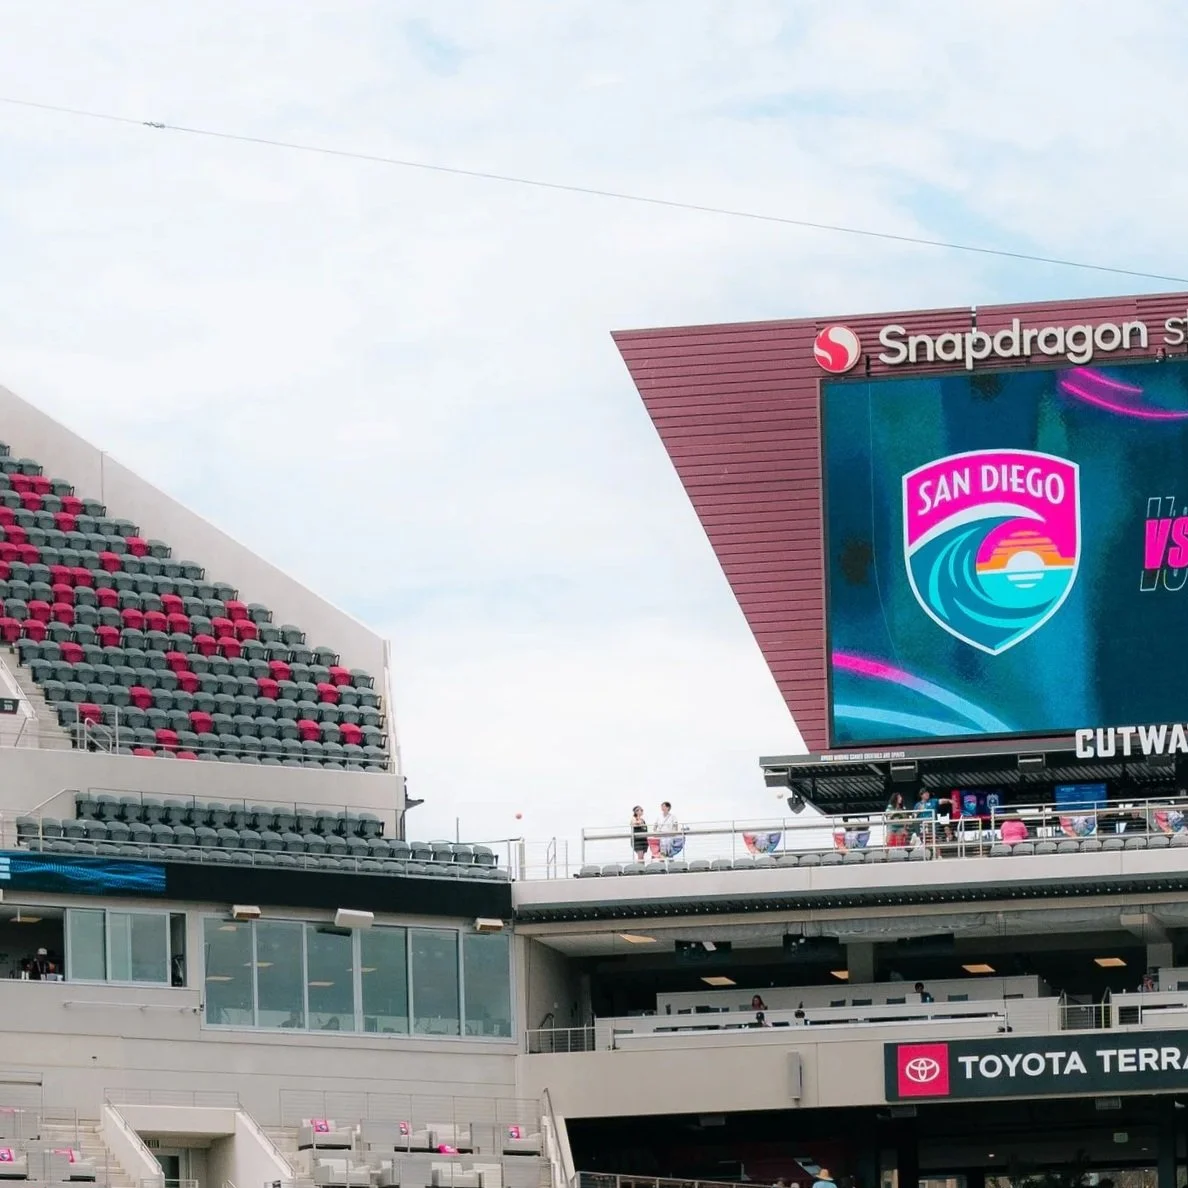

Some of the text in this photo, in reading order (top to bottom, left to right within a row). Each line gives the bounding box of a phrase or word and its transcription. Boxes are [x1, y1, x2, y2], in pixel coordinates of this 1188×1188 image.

[878, 318, 1148, 370] Snapdragon
[917, 464, 1065, 516] SAN DIEGO
[958, 1051, 1087, 1079] TOYOTA
